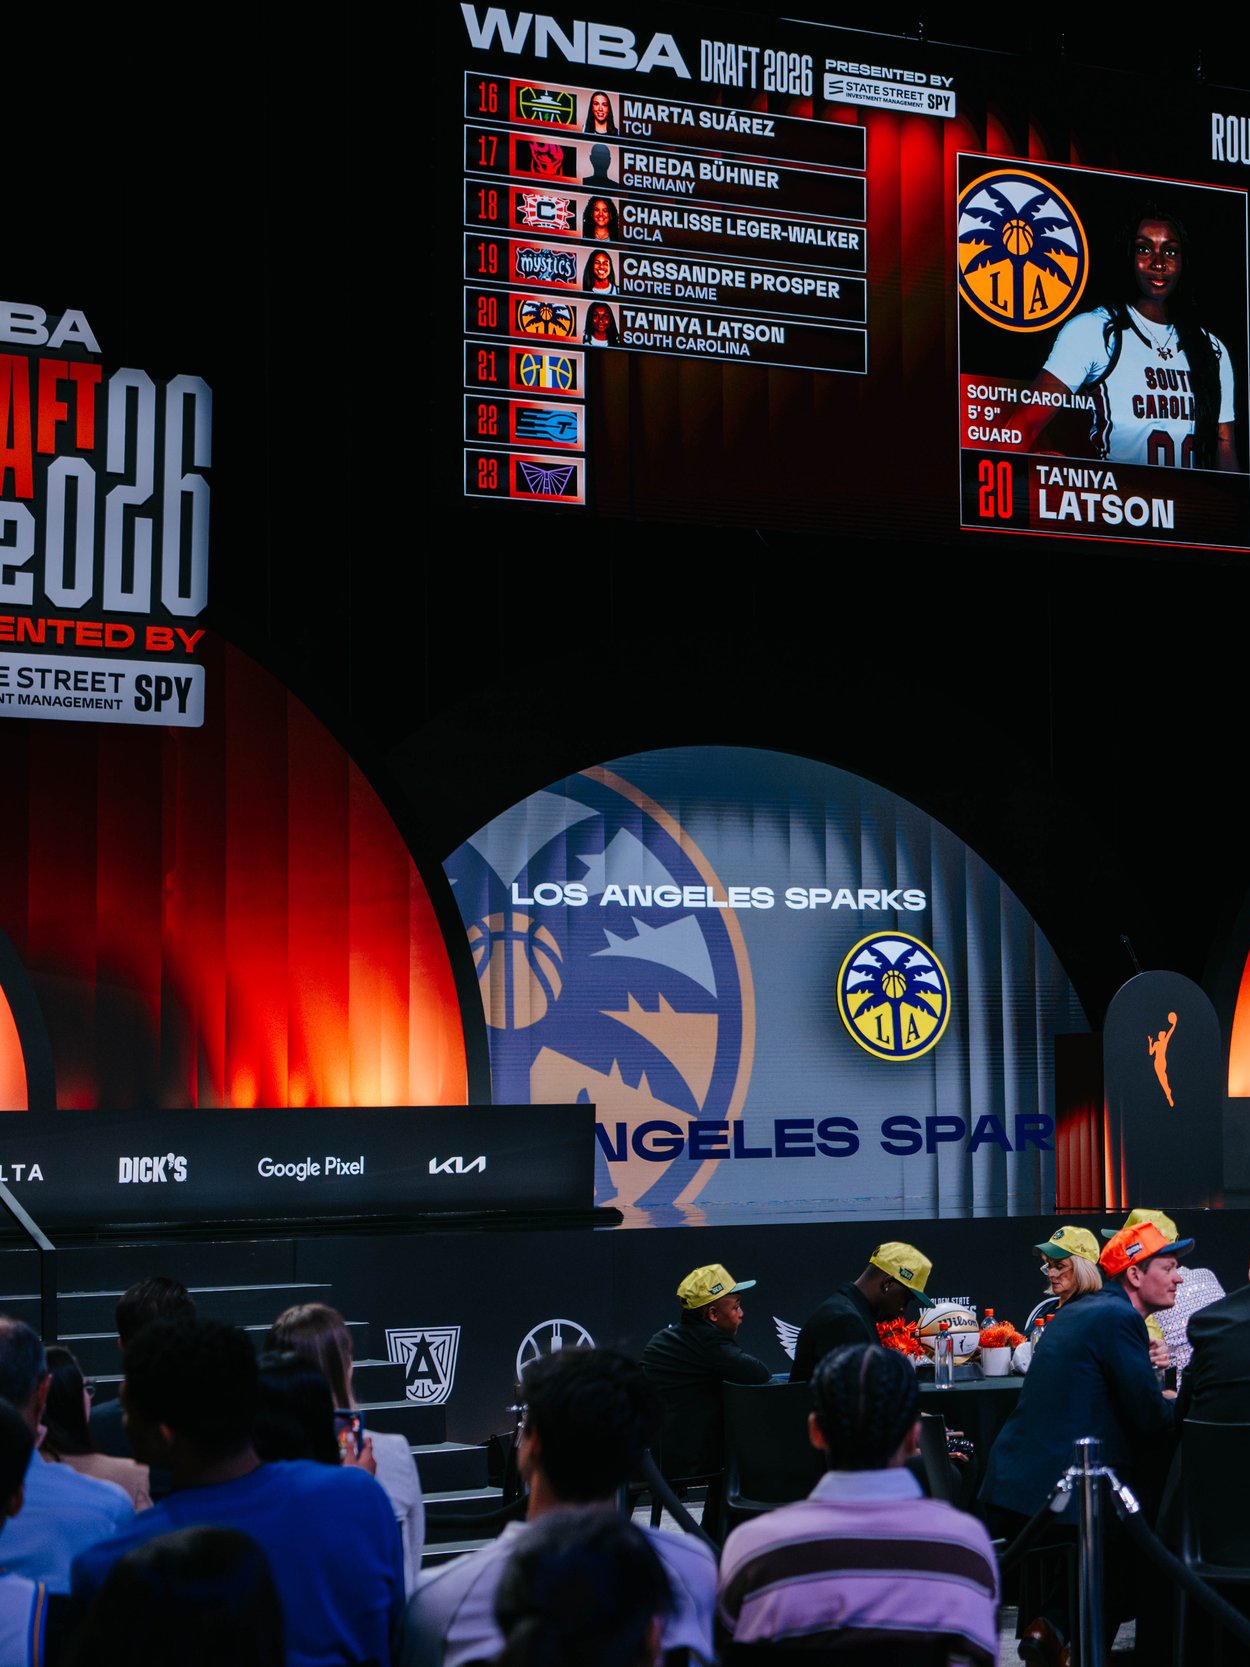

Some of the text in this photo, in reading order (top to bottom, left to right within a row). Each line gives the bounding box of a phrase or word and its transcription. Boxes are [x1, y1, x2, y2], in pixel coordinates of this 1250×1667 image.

[460, 2, 813, 97] WNBA DRAFT 2026
[825, 59, 954, 88] PRESENTED BY
[478, 81, 498, 113] 16
[846, 82, 951, 112] STATE STREET SPY
[846, 92, 924, 108] INVESTMENT MANAGEMENT
[623, 100, 776, 137] MARTA SUÁREZ
[623, 120, 652, 136] TCU
[478, 135, 498, 167] 17
[623, 152, 780, 189] FRIEDA BÜHNER
[623, 173, 696, 194] GERMANY
[478, 188, 498, 221] 18
[622, 205, 860, 250] CHARLISSE LEGER-WALKER
[622, 225, 663, 243] UCLA
[478, 242, 498, 274] 19
[622, 258, 840, 299] CASSANDRE PROSPER
[623, 278, 717, 301] NOTRE DAME
[989, 271, 1049, 314] L A
[477, 296, 498, 328] 20
[622, 310, 785, 344] TA'NIYA LATSON
[623, 331, 751, 356] SOUTH CAROLINA
[477, 350, 497, 382] 21
[967, 384, 1096, 411] SOUTH CAROLINA
[967, 405, 1001, 422] 5' 9"
[478, 404, 498, 436] 22
[557, 421, 573, 435] T
[967, 426, 1022, 445] GUARD
[478, 458, 498, 490] 23
[978, 459, 1013, 519] 20
[1036, 465, 1118, 491] TA'NIYA
[0, 367, 213, 617] 2026
[1038, 489, 1175, 529] LATSON
[145, 625, 207, 654] BY
[16, 667, 126, 693] STREET
[134, 674, 193, 714] SPY
[18, 694, 124, 711] MANAGEMENT
[511, 882, 927, 911] LOS ANGELES SPARKS
[875, 1011, 921, 1045] L A
[119, 1153, 188, 1183] DICK'S
[257, 1155, 365, 1182] Google Pixel
